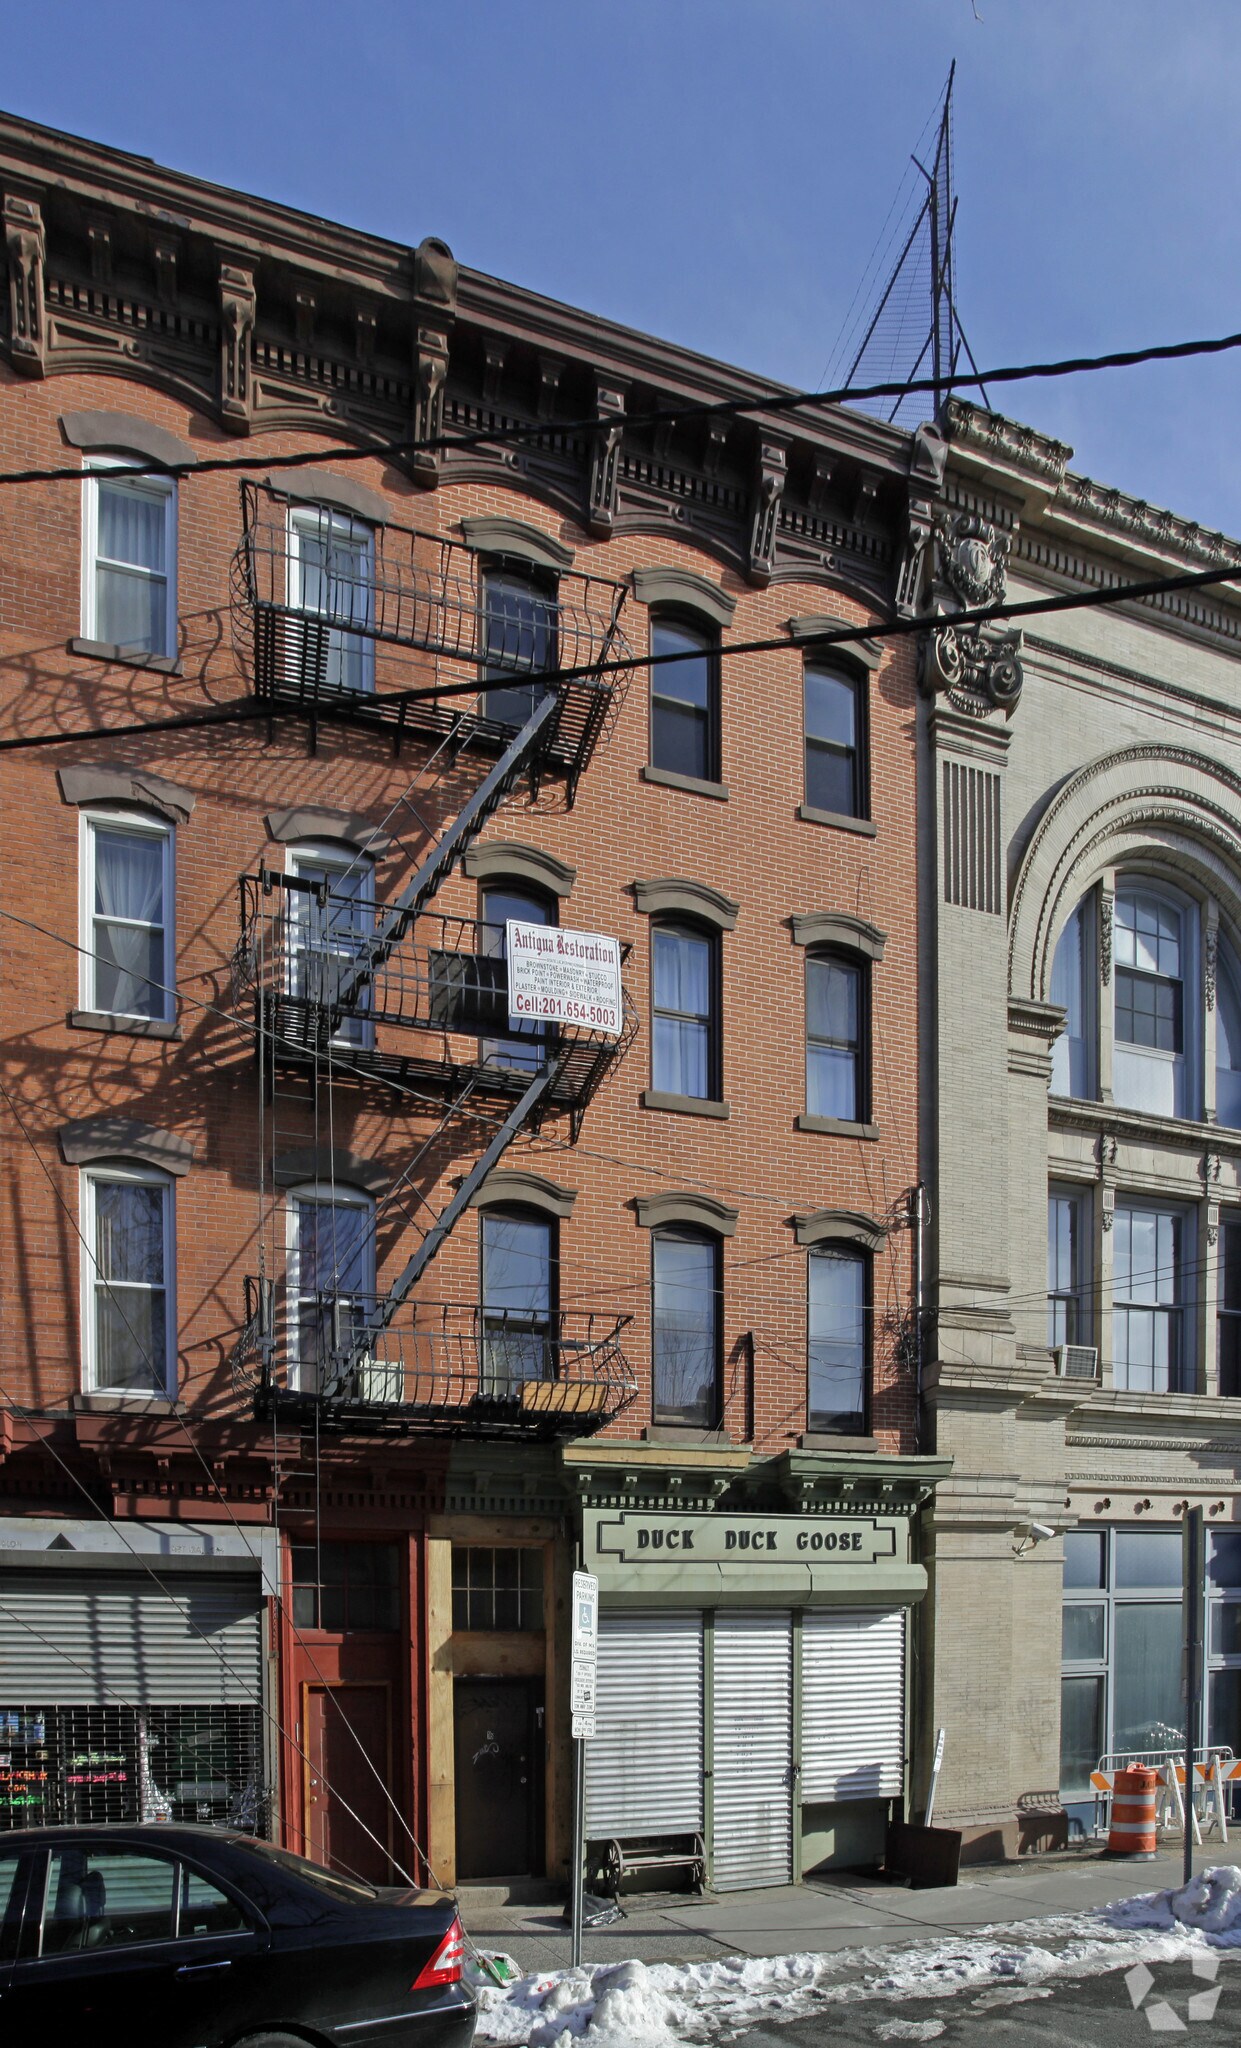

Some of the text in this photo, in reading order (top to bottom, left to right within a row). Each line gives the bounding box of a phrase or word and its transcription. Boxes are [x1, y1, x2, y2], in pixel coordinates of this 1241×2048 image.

[514, 927, 615, 964] Antigua Restoration
[516, 966, 614, 990] BRICK POINT POWERWASH WATERPROOF
[526, 961, 559, 973] BROWNSTONE
[562, 966, 585, 976] MASONRY
[588, 971, 608, 981] STUCCO
[515, 981, 616, 1006] PLASTER MOULDING SIDEWALK ROOFING
[534, 976, 598, 994] PAINT INTERIOR & EXTERIOR
[636, 1528, 863, 1552] DUCK DUCK GOOSE
[575, 1578, 596, 1591] RESERVED
[576, 1590, 595, 1603] PARKING
